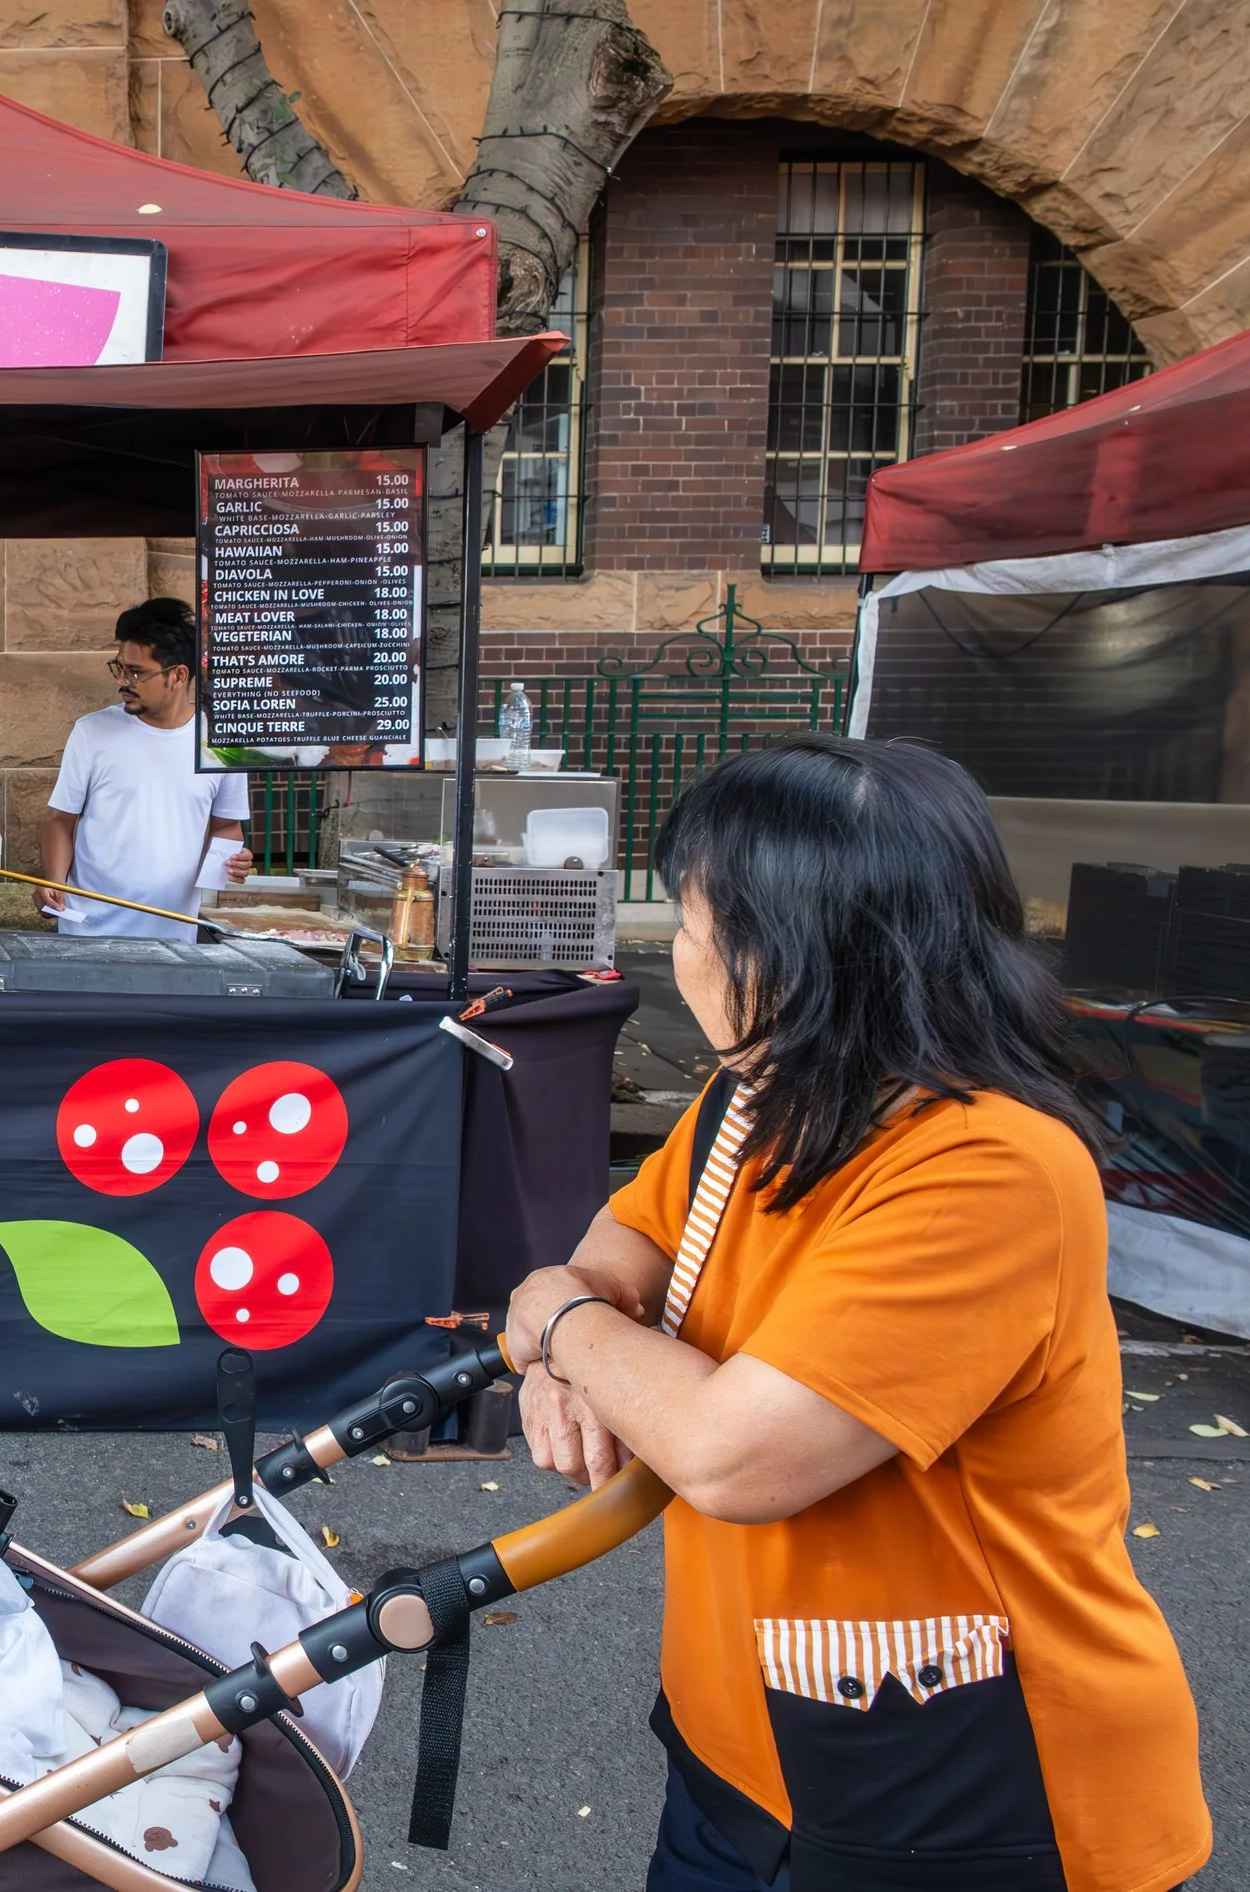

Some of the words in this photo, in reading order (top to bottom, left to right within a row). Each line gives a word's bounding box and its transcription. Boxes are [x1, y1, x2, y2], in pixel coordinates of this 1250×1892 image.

[214, 477, 300, 490] MARGHERITA
[375, 474, 409, 486] 15.00
[216, 501, 262, 513] GARLIC
[375, 498, 409, 509] 15.00
[214, 523, 300, 537] CAPRICCIOSA
[375, 521, 409, 533] 15.00
[215, 545, 282, 558] HAWAIIAN
[375, 542, 409, 554] 15.00
[215, 568, 273, 581] DIAVOLA
[375, 565, 409, 577] 15.00
[214, 590, 270, 602] CHICKEN
[274, 589, 288, 601] IN
[292, 588, 324, 600] LOVE
[374, 587, 408, 599] 18.00
[215, 612, 251, 624] MEAT
[254, 611, 295, 623] LOVER
[374, 608, 408, 620] 18.00
[213, 630, 292, 643] VEGETERIAN
[374, 628, 408, 639] 18.00
[211, 655, 255, 667] THAT'S
[258, 654, 305, 666] AMORE
[373, 652, 407, 663] 20.00
[213, 676, 273, 689] SUPREME
[373, 674, 408, 685] 20.00
[213, 699, 250, 711] SOFIA
[253, 698, 296, 710] LOREN
[374, 696, 408, 708] 25.00
[214, 722, 264, 735] CINQUE
[266, 721, 305, 732] TERRE
[376, 719, 410, 730] 29.00
